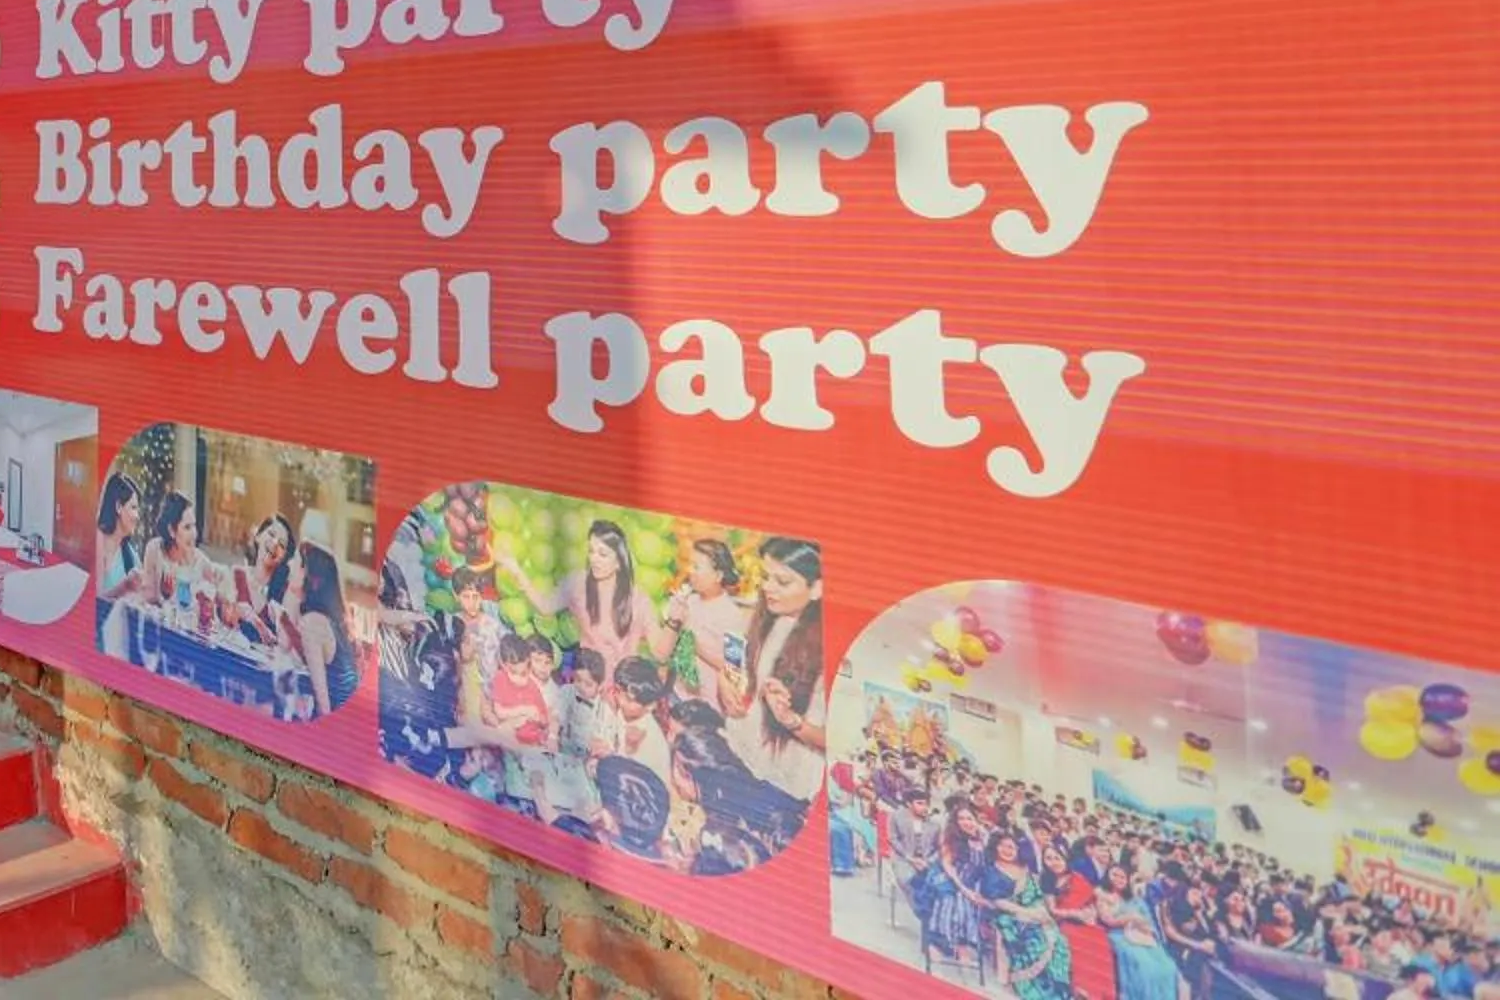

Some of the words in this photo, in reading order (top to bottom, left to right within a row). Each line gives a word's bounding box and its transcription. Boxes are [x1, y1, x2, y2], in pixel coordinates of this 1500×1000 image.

[34, 104, 504, 238] Birthday
[549, 80, 1149, 257] party
[32, 245, 499, 389] Farewell
[544, 309, 1146, 498] party
